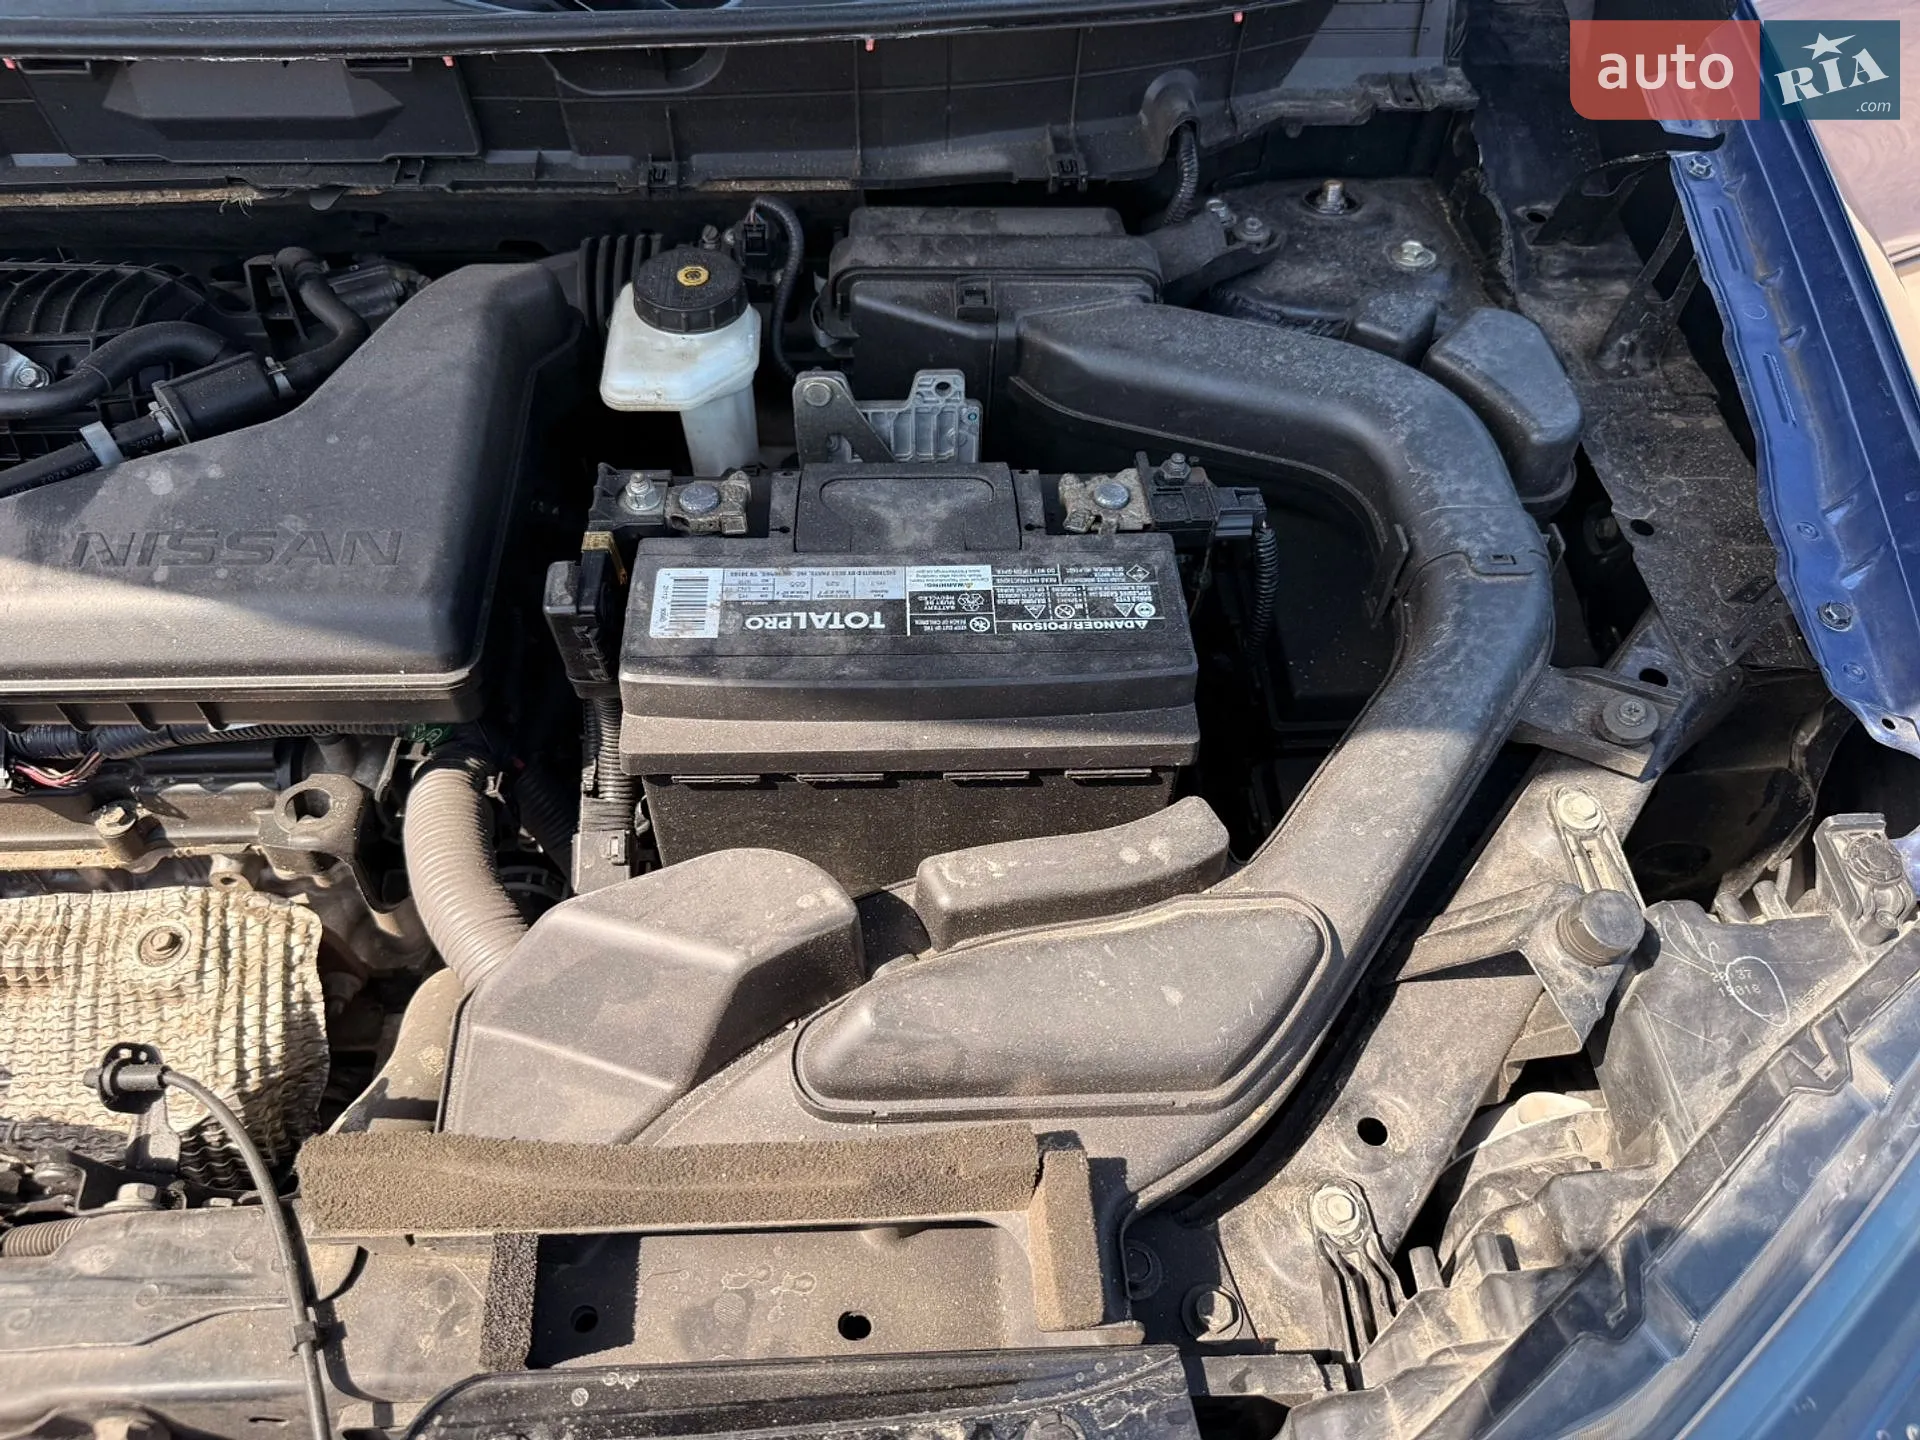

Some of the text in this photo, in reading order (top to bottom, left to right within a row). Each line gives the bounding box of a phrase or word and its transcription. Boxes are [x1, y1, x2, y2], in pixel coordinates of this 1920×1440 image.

[70, 529, 404, 568] NISSAN
[745, 611, 886, 630] TOTALPRO
[1012, 621, 1135, 631] DANGER/POISON
